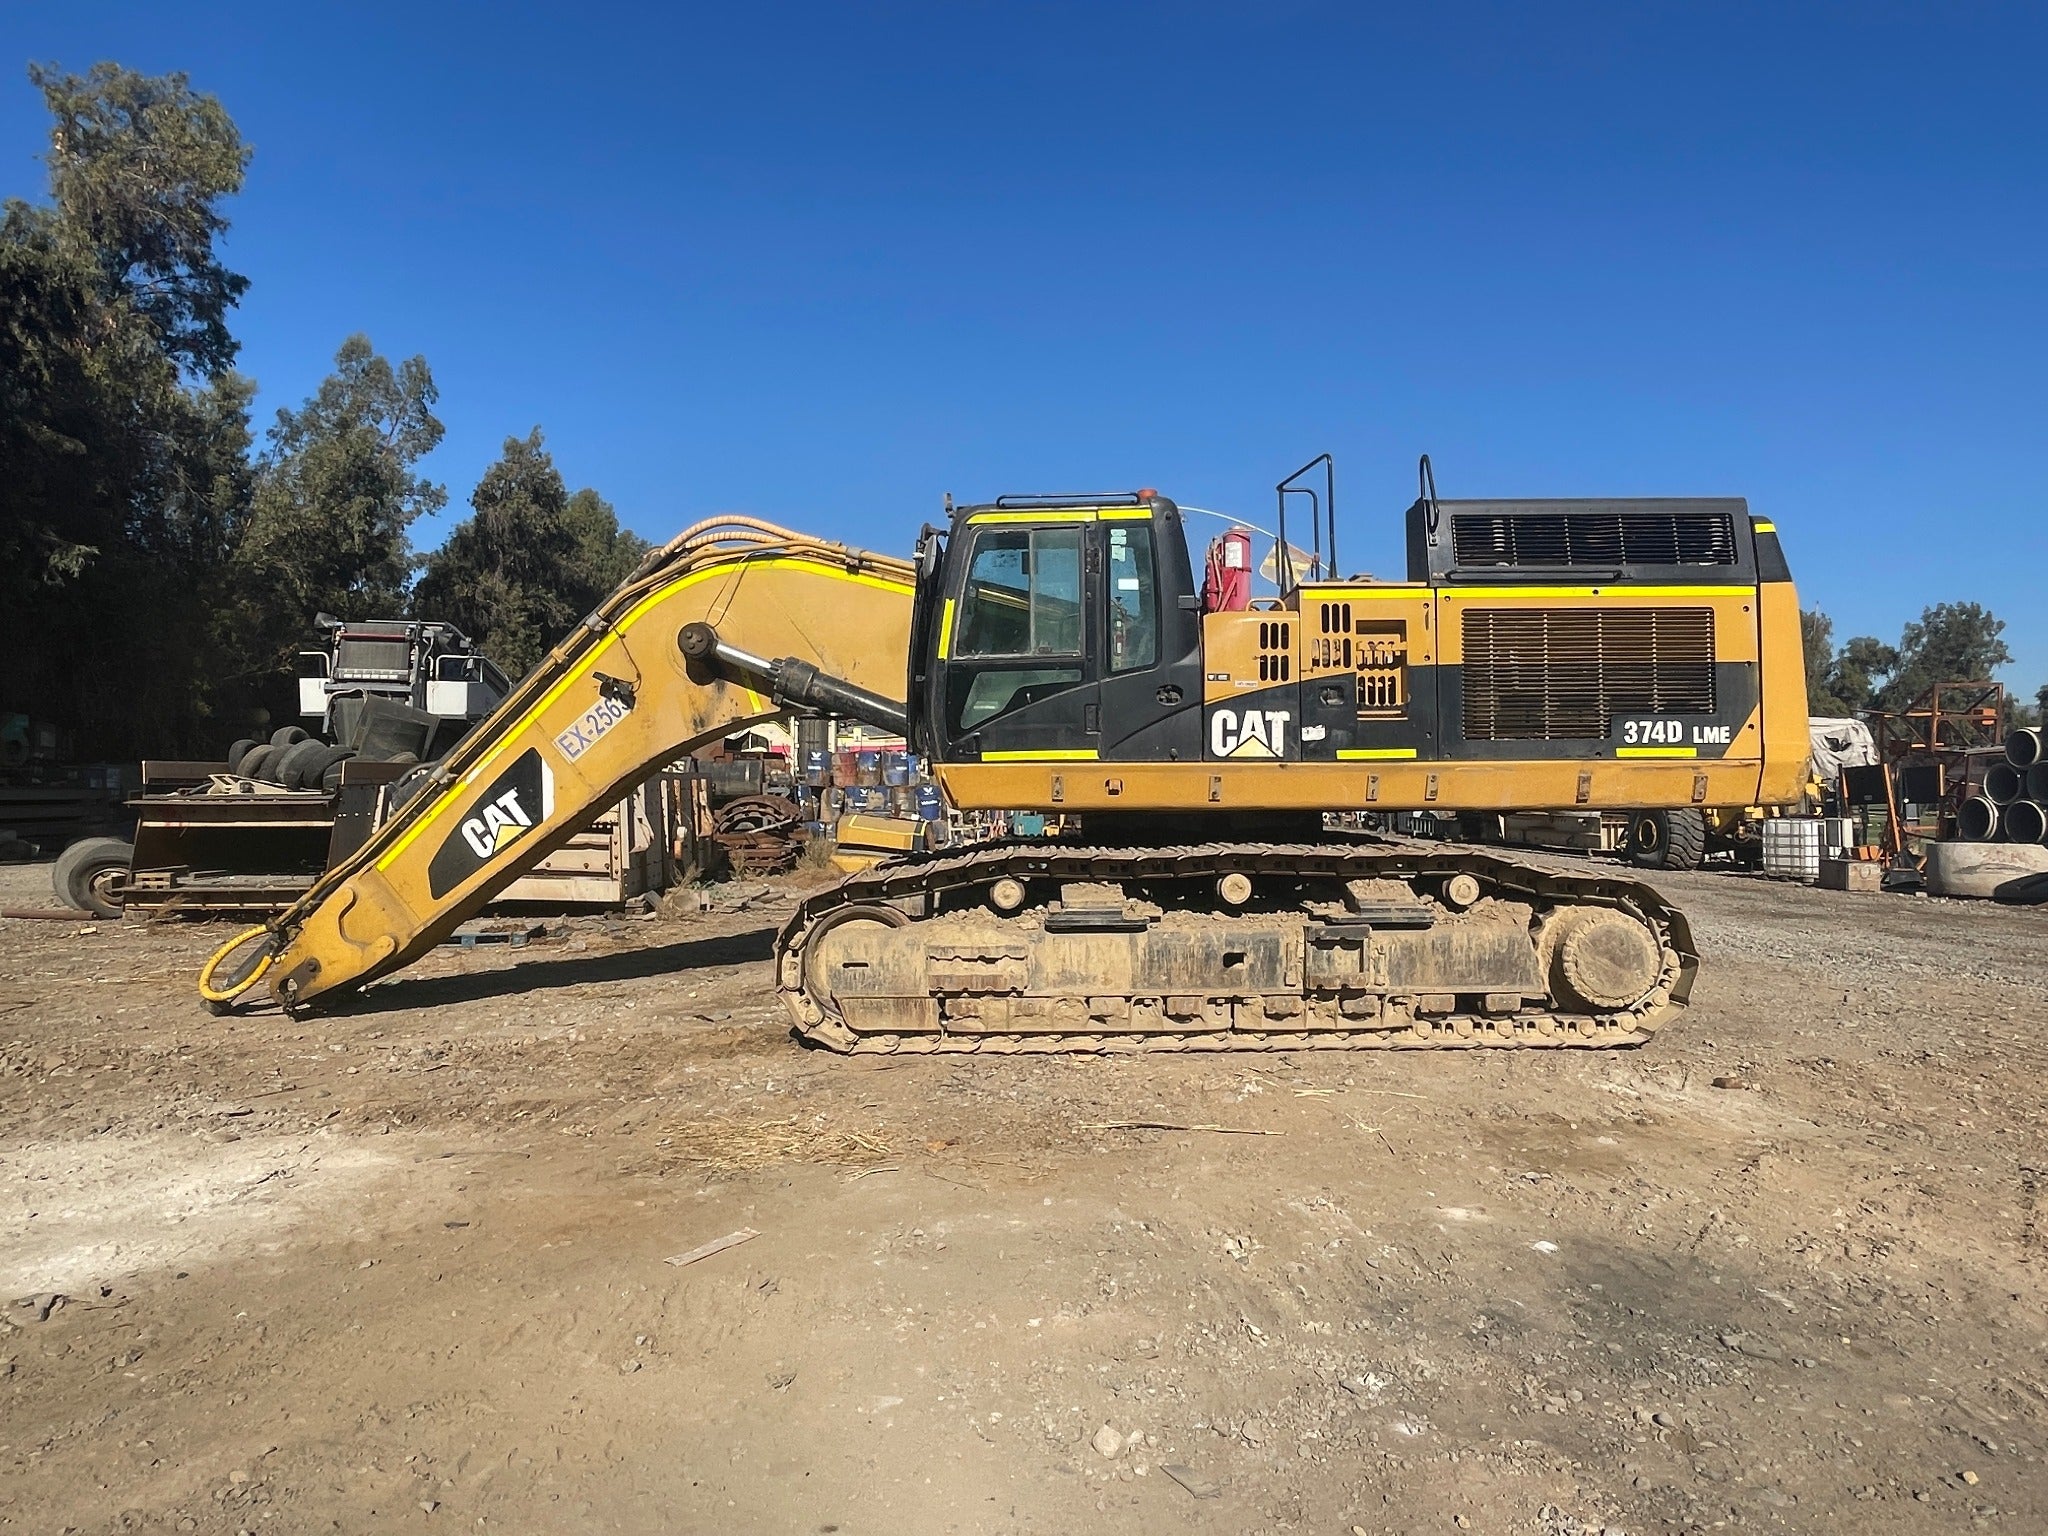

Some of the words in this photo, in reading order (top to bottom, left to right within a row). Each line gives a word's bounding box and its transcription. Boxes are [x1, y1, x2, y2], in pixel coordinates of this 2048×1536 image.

[1211, 709, 1291, 758] CAT
[1623, 720, 1683, 744] 374D
[1692, 725, 1731, 744] LME
[461, 788, 533, 859] CAT
